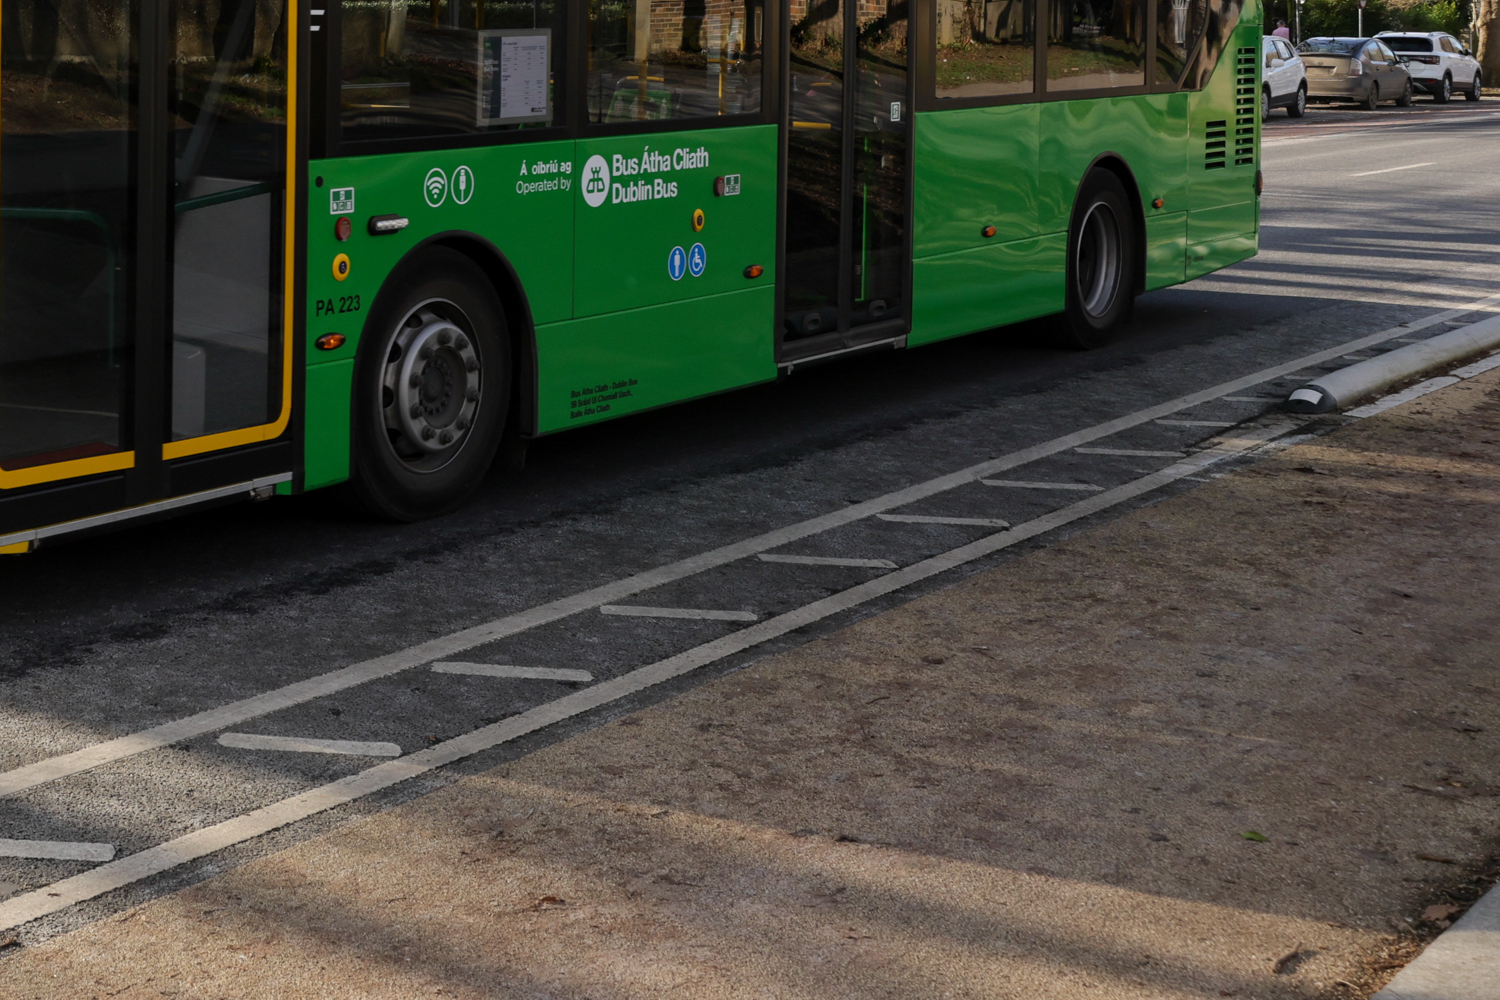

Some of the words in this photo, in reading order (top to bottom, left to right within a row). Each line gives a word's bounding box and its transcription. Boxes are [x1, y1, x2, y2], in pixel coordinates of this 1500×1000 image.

[519, 159, 528, 176] Á
[531, 159, 558, 175] oibriú
[560, 161, 572, 174] ag
[612, 154, 639, 176] Bus
[640, 145, 671, 174] Átha
[672, 147, 709, 171] Cliath
[516, 177, 559, 195] Operated
[560, 176, 572, 192] by
[612, 180, 652, 204] Dublin
[653, 178, 678, 199] Bus
[316, 298, 335, 317] PA
[338, 294, 362, 314] 223
